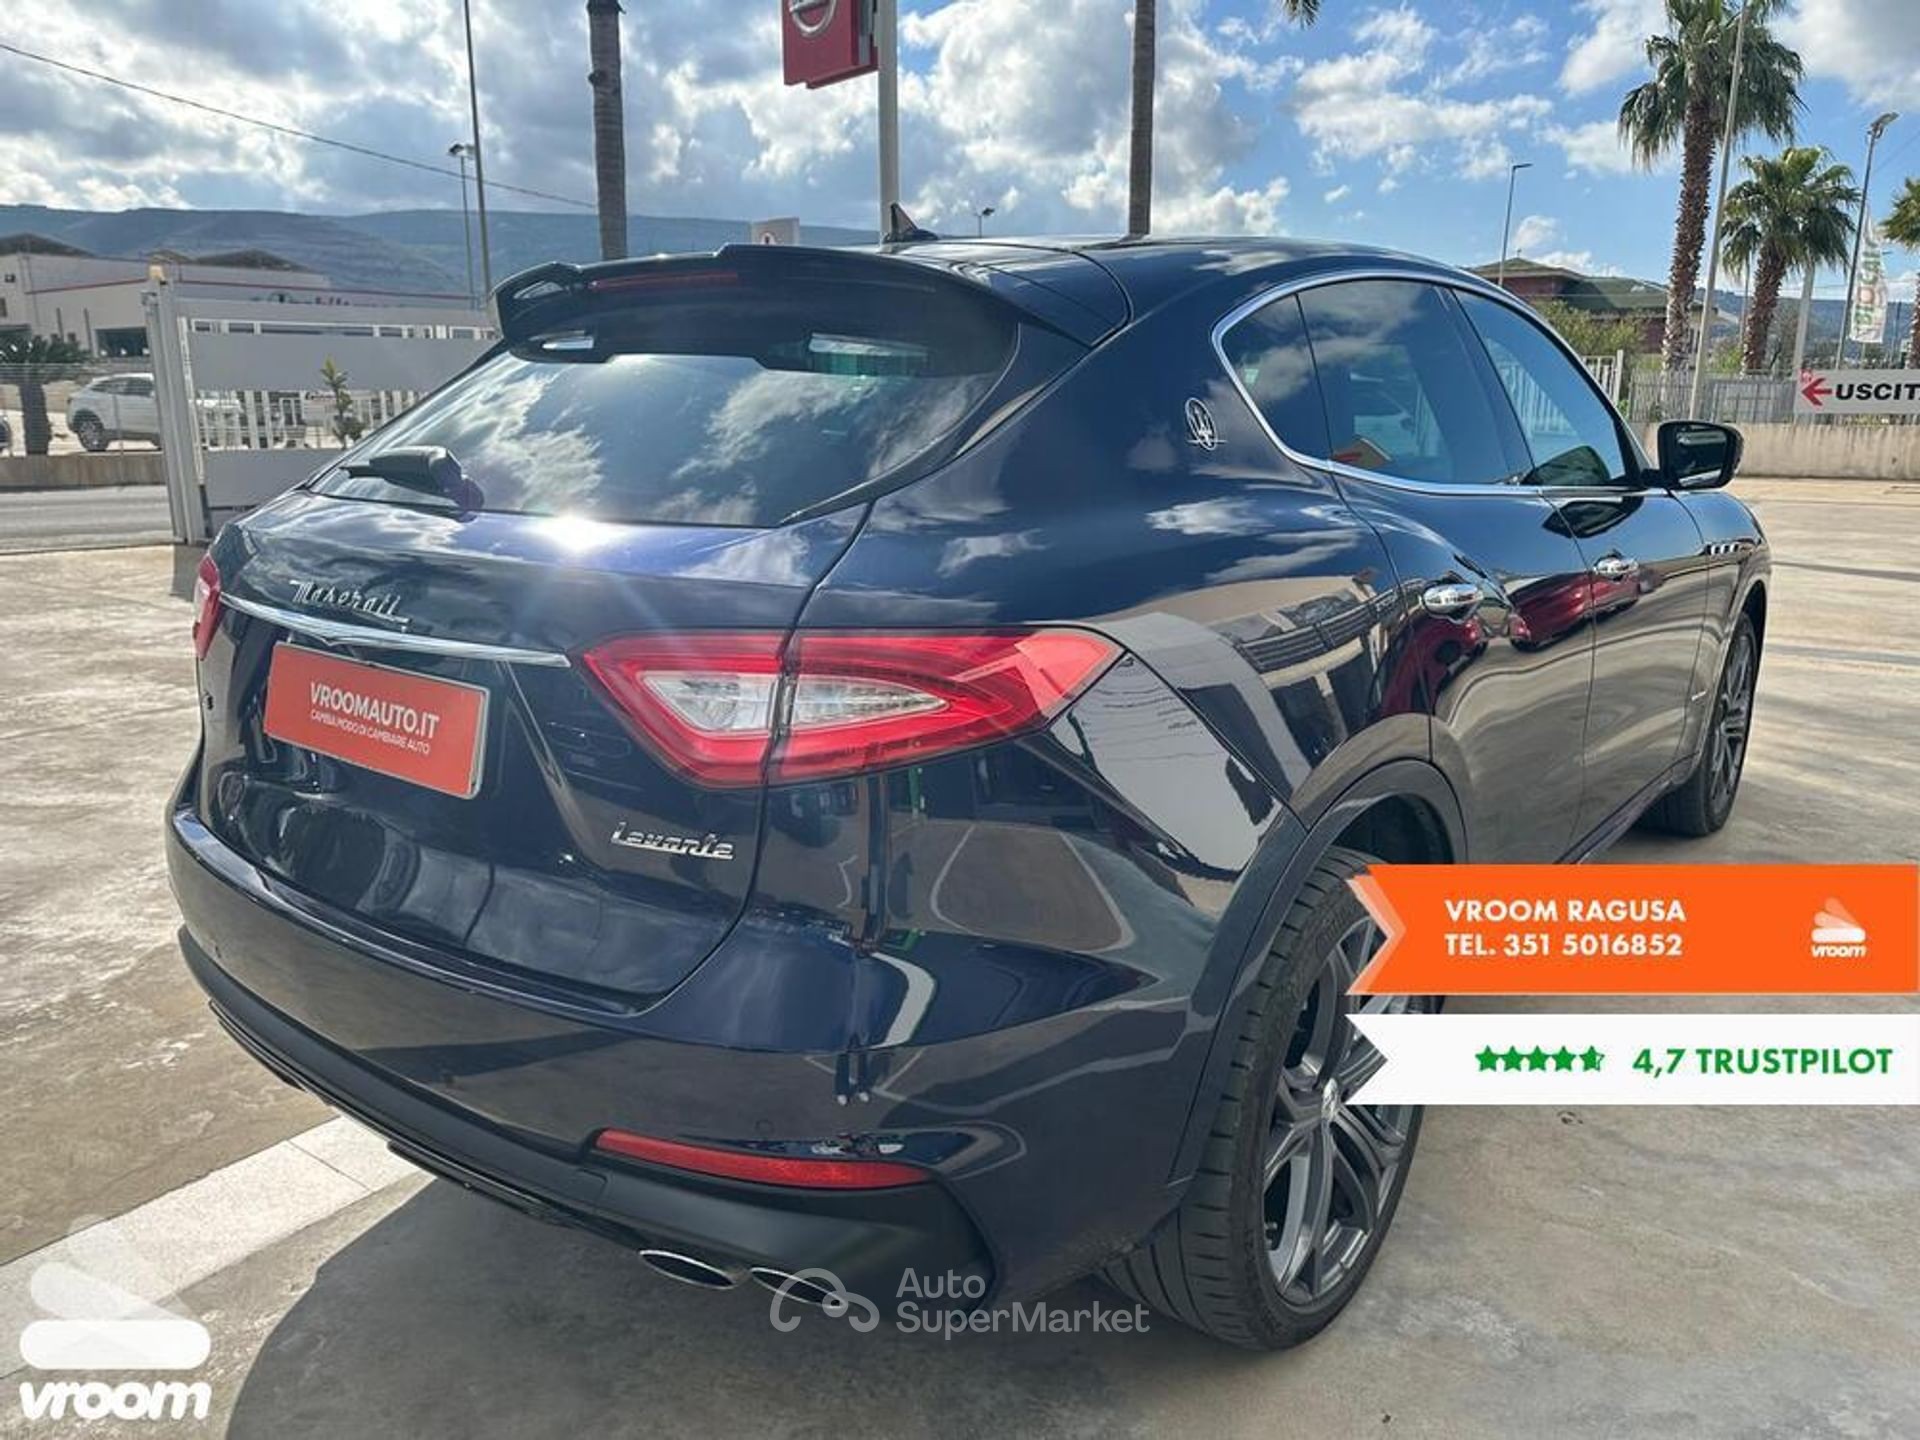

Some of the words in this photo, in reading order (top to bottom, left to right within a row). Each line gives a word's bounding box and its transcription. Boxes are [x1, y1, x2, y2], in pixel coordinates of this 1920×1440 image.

[1835, 383, 1920, 401] USCIT
[289, 580, 410, 622] Maserati
[310, 681, 440, 738] VROOMAUTO.IT
[338, 716, 358, 734] MODO
[366, 727, 407, 749] CAMBIARE
[407, 738, 431, 755] AUTO
[610, 821, 734, 860] Levante
